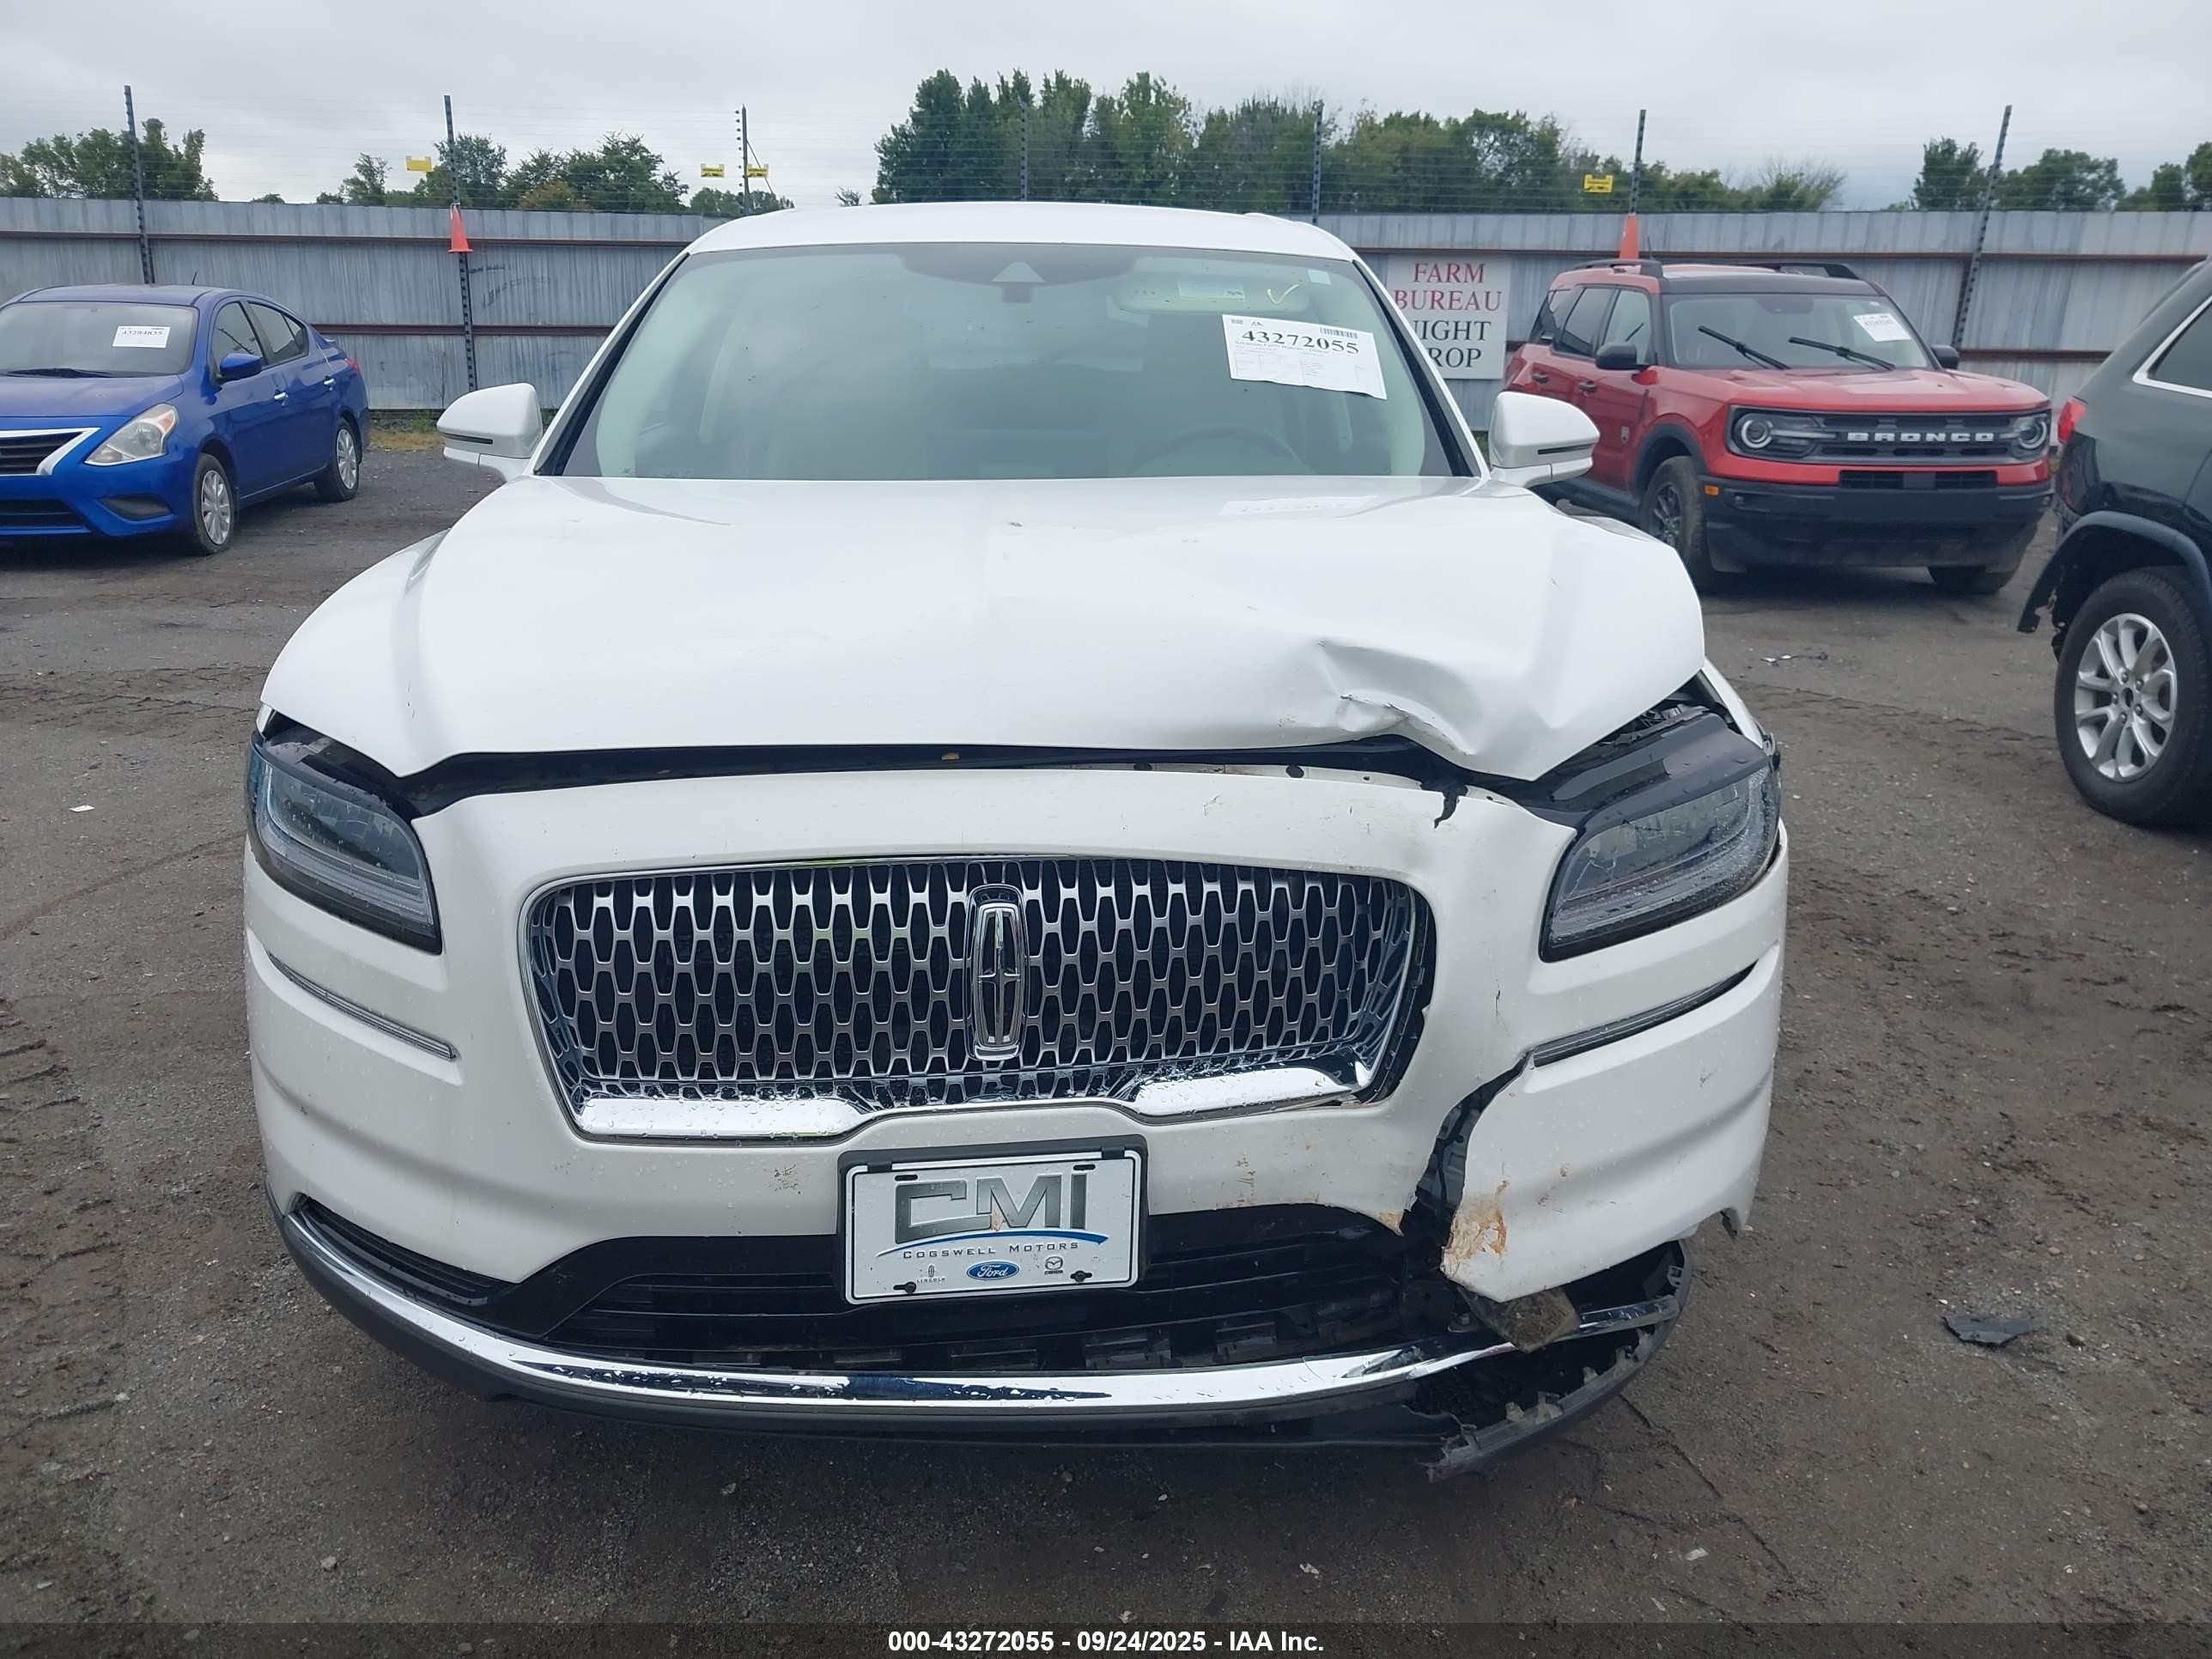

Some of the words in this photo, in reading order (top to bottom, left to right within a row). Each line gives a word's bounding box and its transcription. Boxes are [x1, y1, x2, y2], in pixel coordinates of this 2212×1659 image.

[1413, 262, 1486, 283] FARM
[1395, 289, 1502, 311] BUREAU
[1242, 330, 1359, 355] 43272055
[1426, 347, 1482, 368] ROP
[1847, 432, 1994, 442] BRONCO
[895, 1173, 1088, 1244] CMI
[902, 1246, 996, 1260] COGSWELL
[1009, 1241, 1079, 1254] MOTORS
[976, 1265, 1010, 1278] Ford
